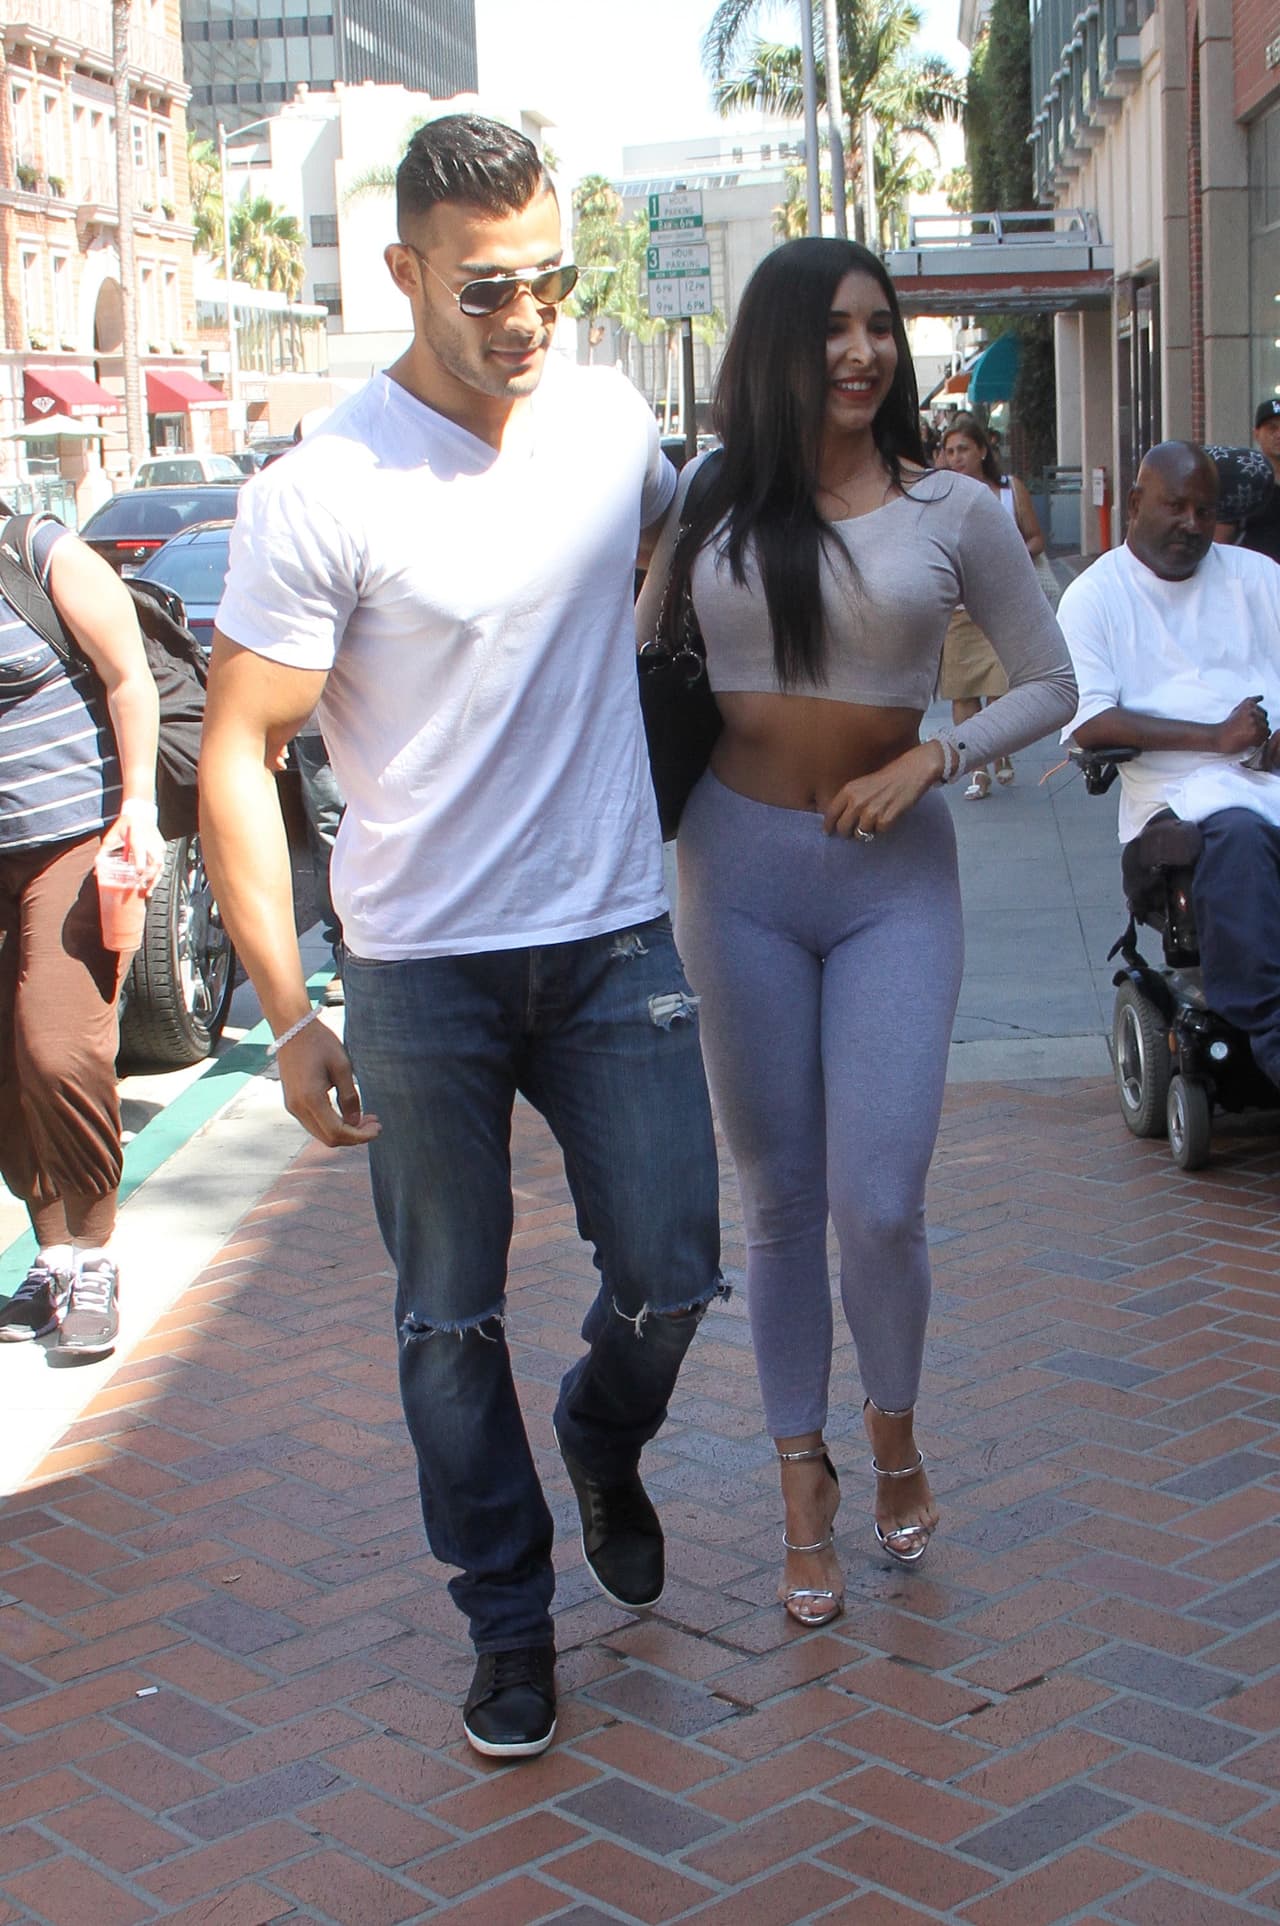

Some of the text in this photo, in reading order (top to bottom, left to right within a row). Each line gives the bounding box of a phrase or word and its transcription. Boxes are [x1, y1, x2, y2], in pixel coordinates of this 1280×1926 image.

[669, 195, 688, 205] HOUR
[651, 197, 657, 216] 1
[664, 207, 694, 217] PARKING
[671, 248, 694, 258] HOUR
[649, 250, 658, 268] 3
[665, 259, 701, 269] PARKING
